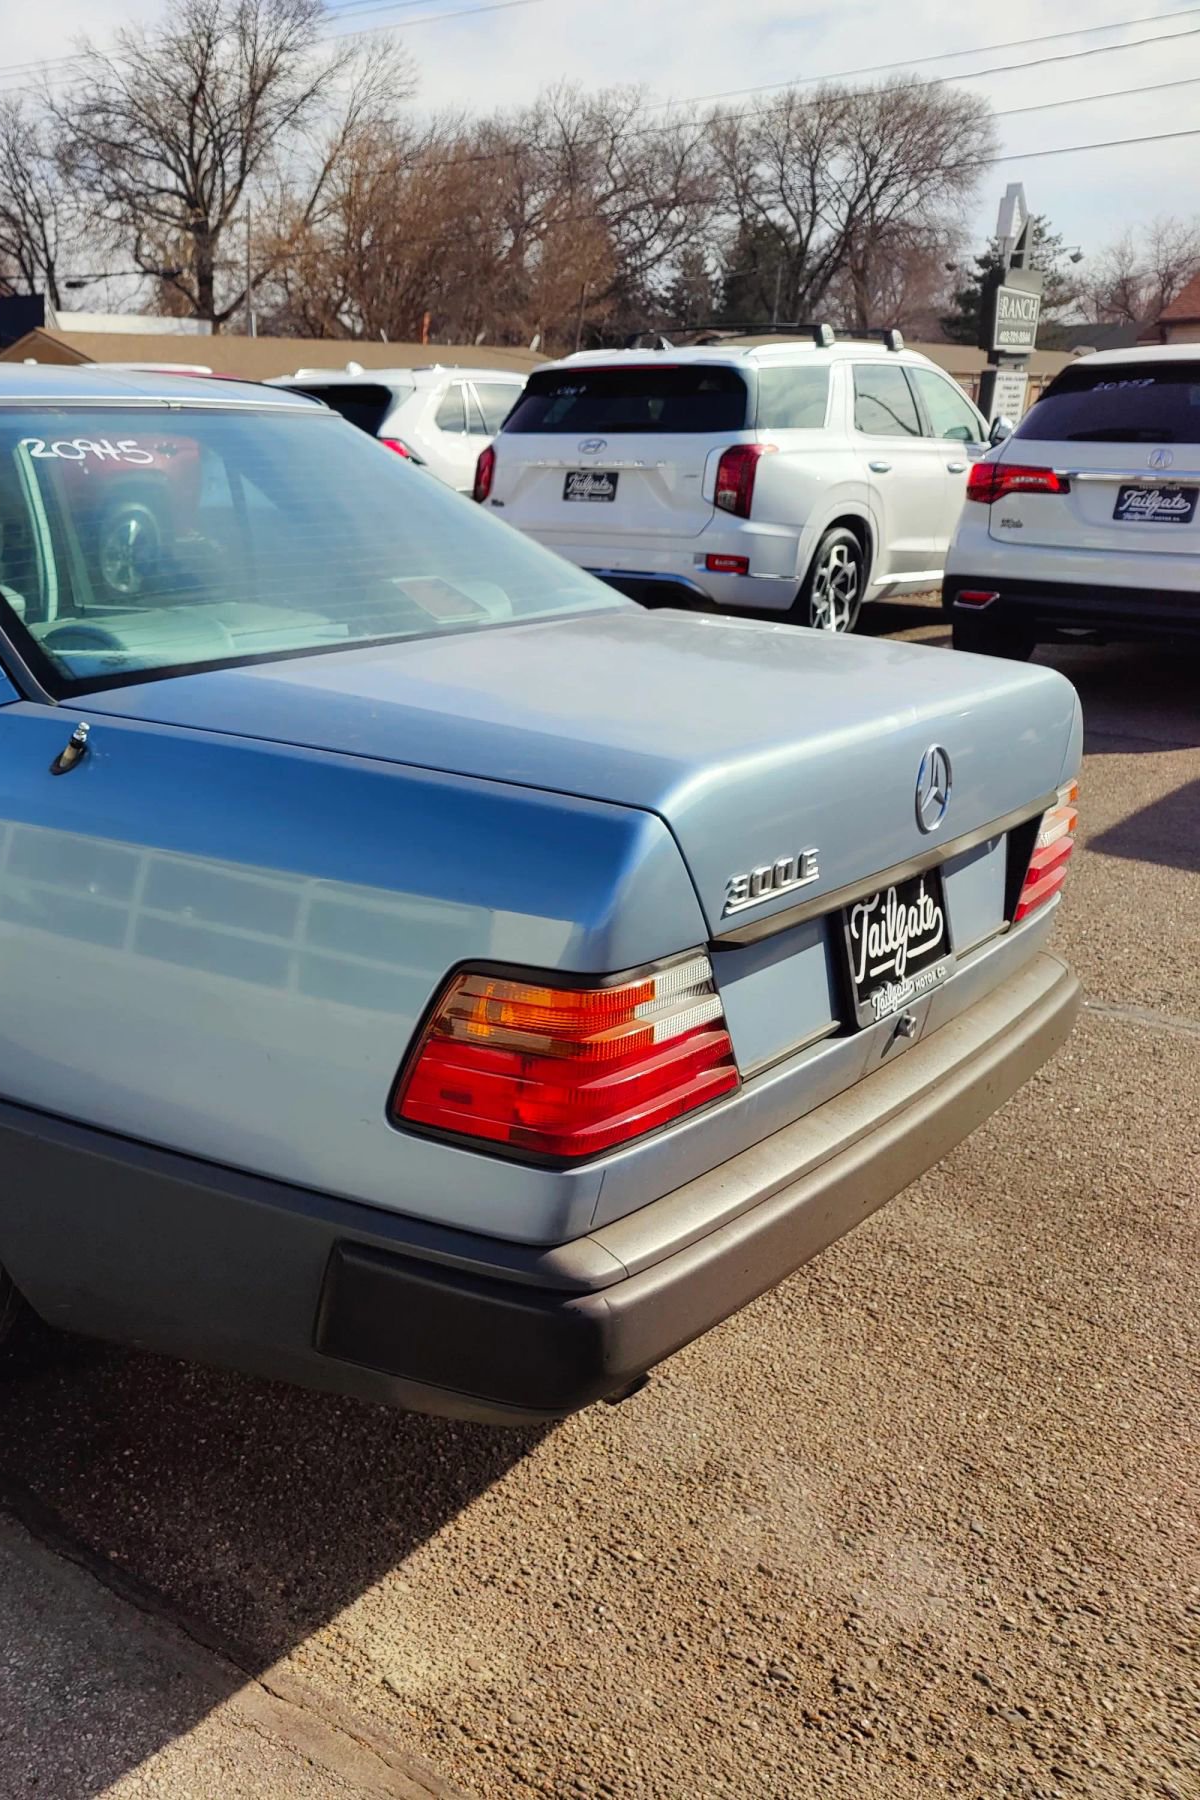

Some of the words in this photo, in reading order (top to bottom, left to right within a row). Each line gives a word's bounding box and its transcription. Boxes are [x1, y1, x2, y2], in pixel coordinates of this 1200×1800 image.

[1002, 296, 1038, 320] RANCH
[19, 437, 154, 464] 20945
[1118, 490, 1192, 517] Tailgate
[850, 879, 944, 984] Tailgate
[871, 974, 915, 1021] Tailgate
[913, 970, 937, 992] MOTOR
